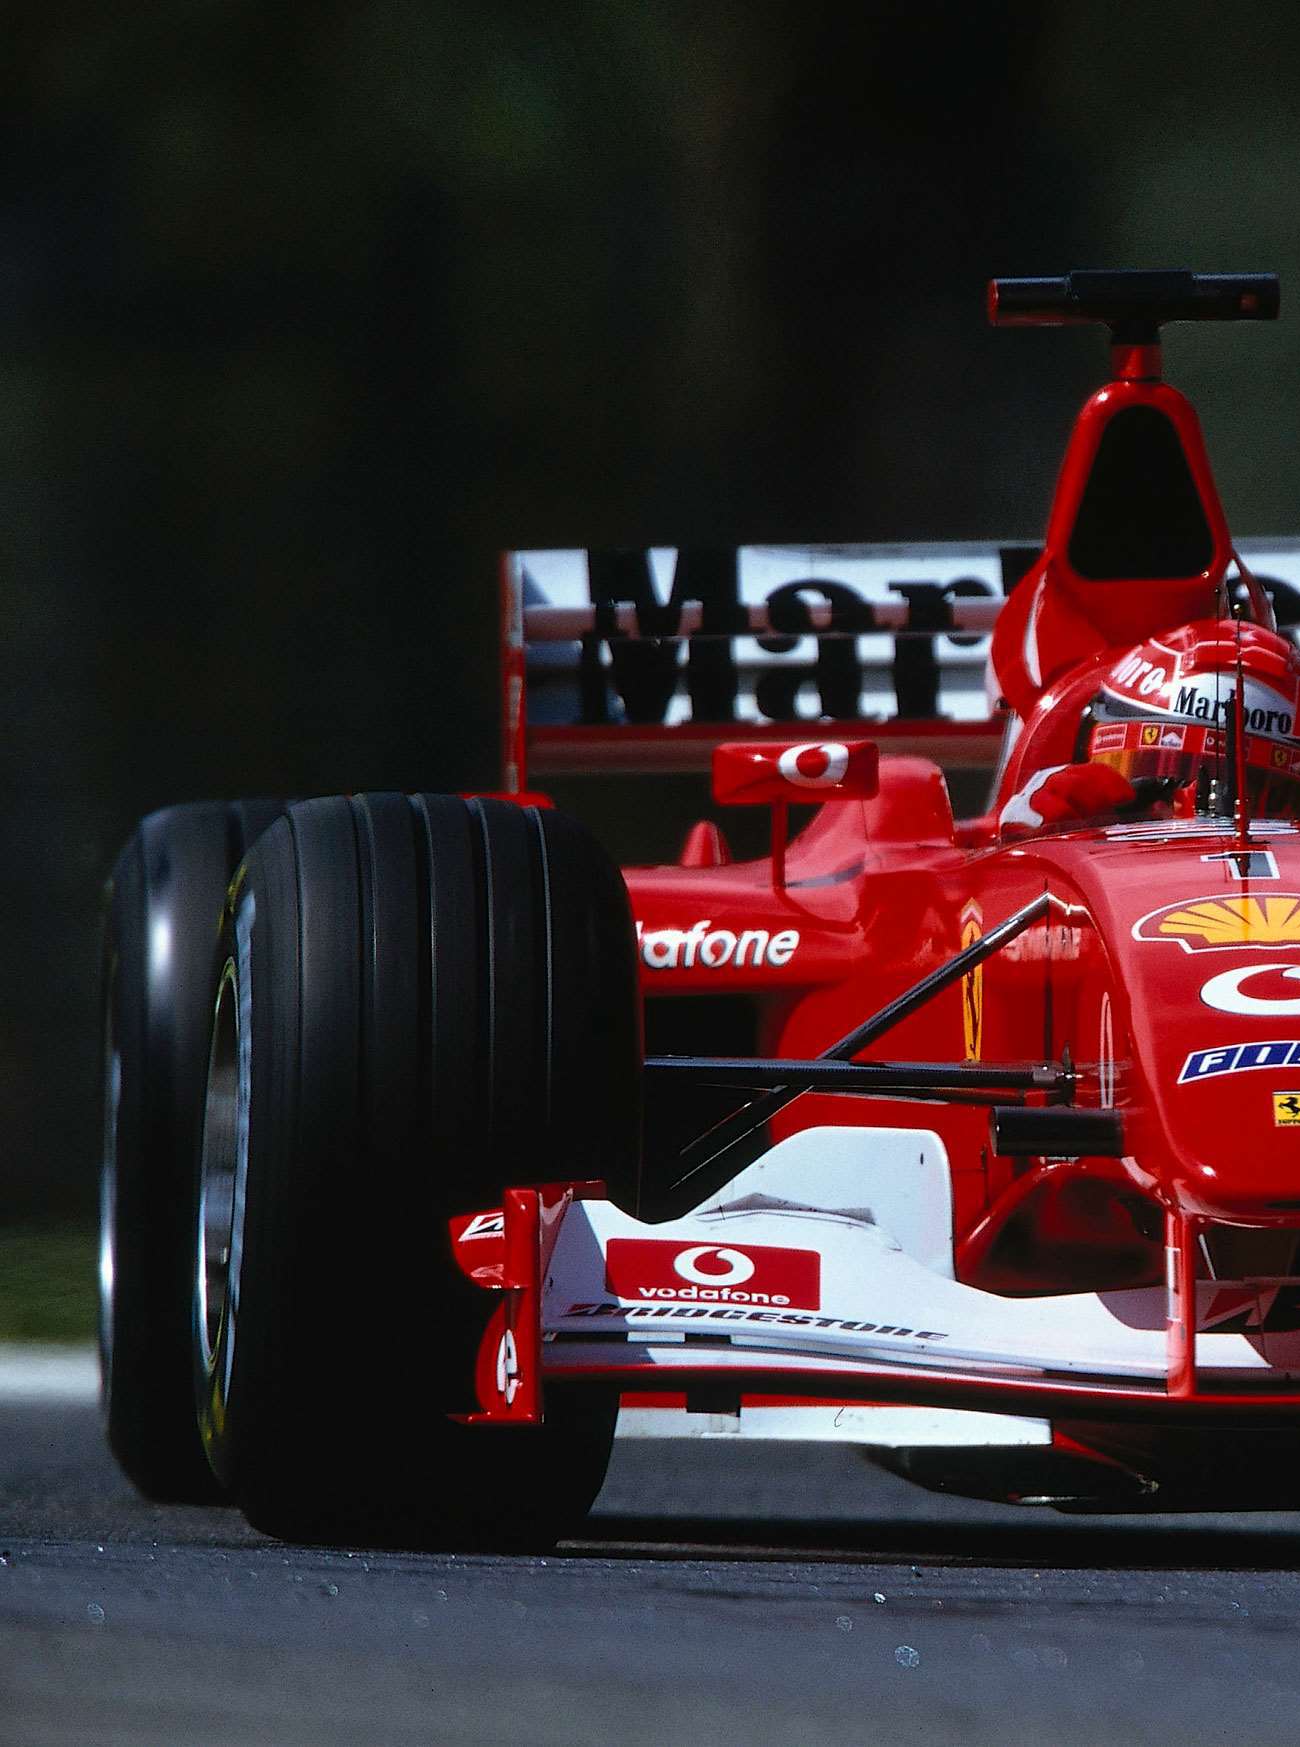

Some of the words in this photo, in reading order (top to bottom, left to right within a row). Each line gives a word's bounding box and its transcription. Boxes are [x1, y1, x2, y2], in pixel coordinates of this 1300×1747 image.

[1173, 686, 1293, 735] Maroro
[636, 920, 800, 969] afone
[638, 1284, 791, 1306] vodafone
[560, 1303, 949, 1342] BRIDGESTONE
